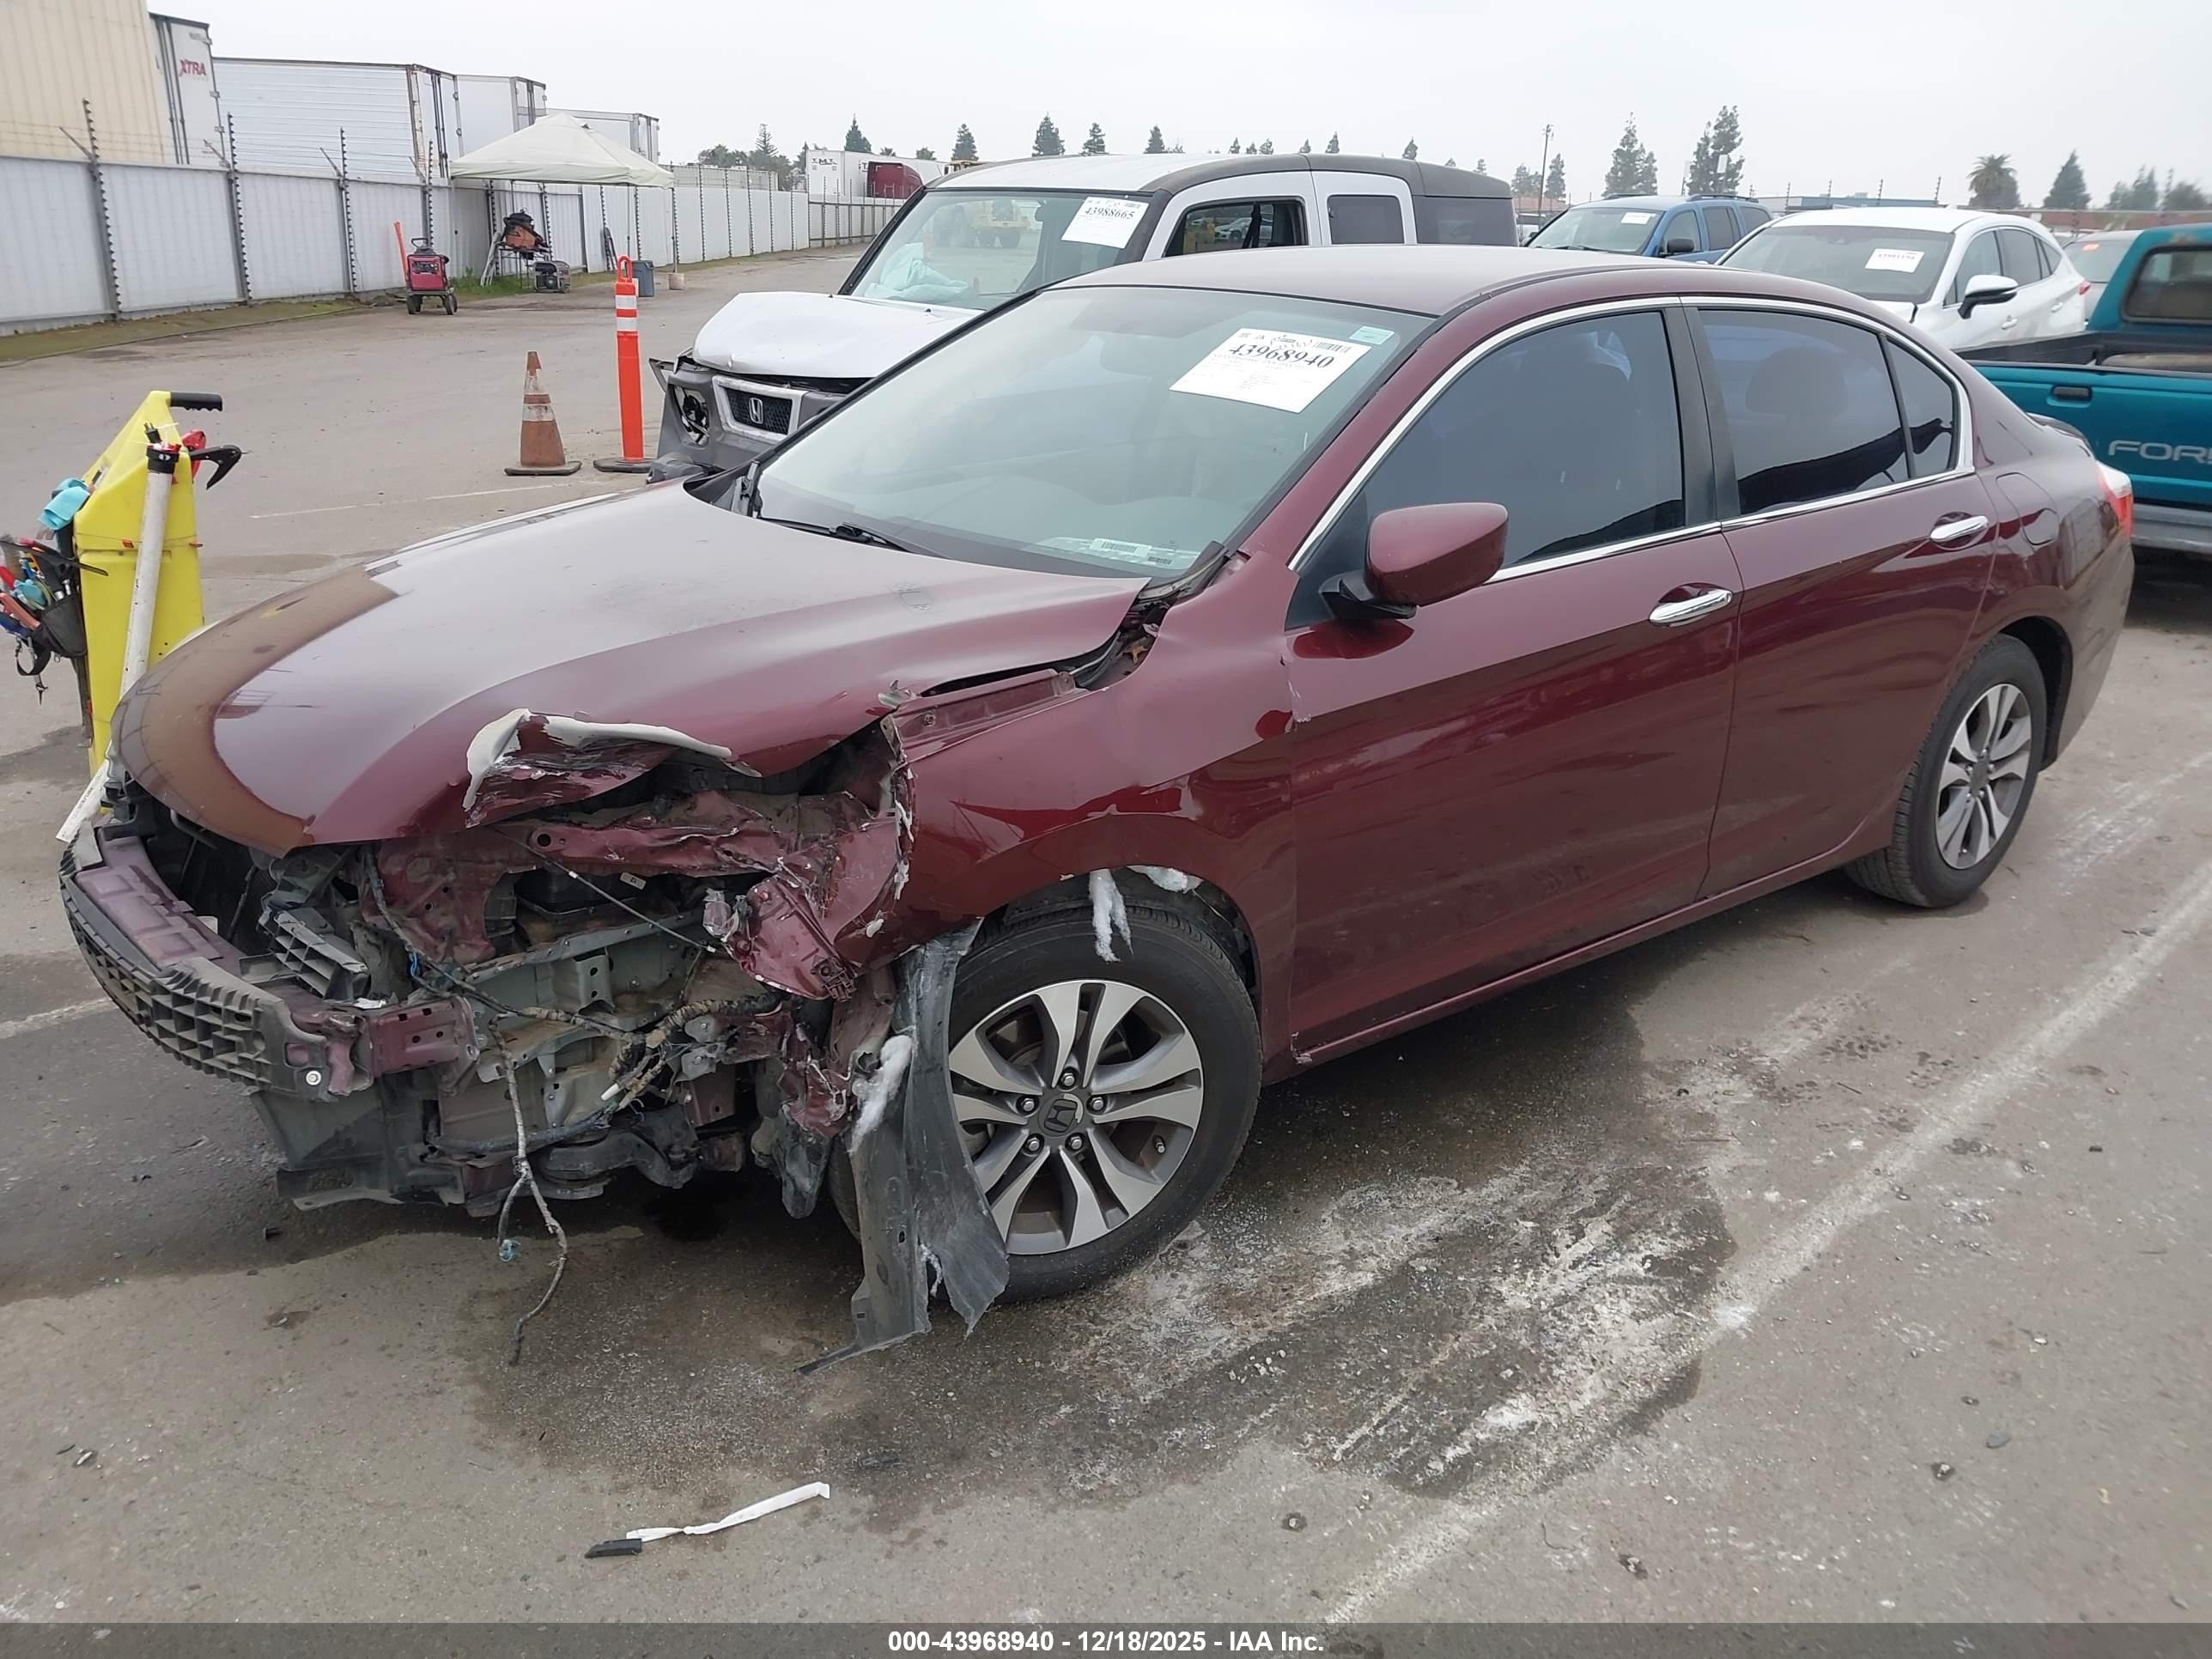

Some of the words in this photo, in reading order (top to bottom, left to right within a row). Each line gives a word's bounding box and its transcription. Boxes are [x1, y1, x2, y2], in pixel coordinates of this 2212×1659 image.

[179, 59, 207, 76] XTRA
[1085, 206, 1135, 220] 43988665
[1230, 343, 1334, 368] 43968940
[2109, 440, 2212, 464] FOR
